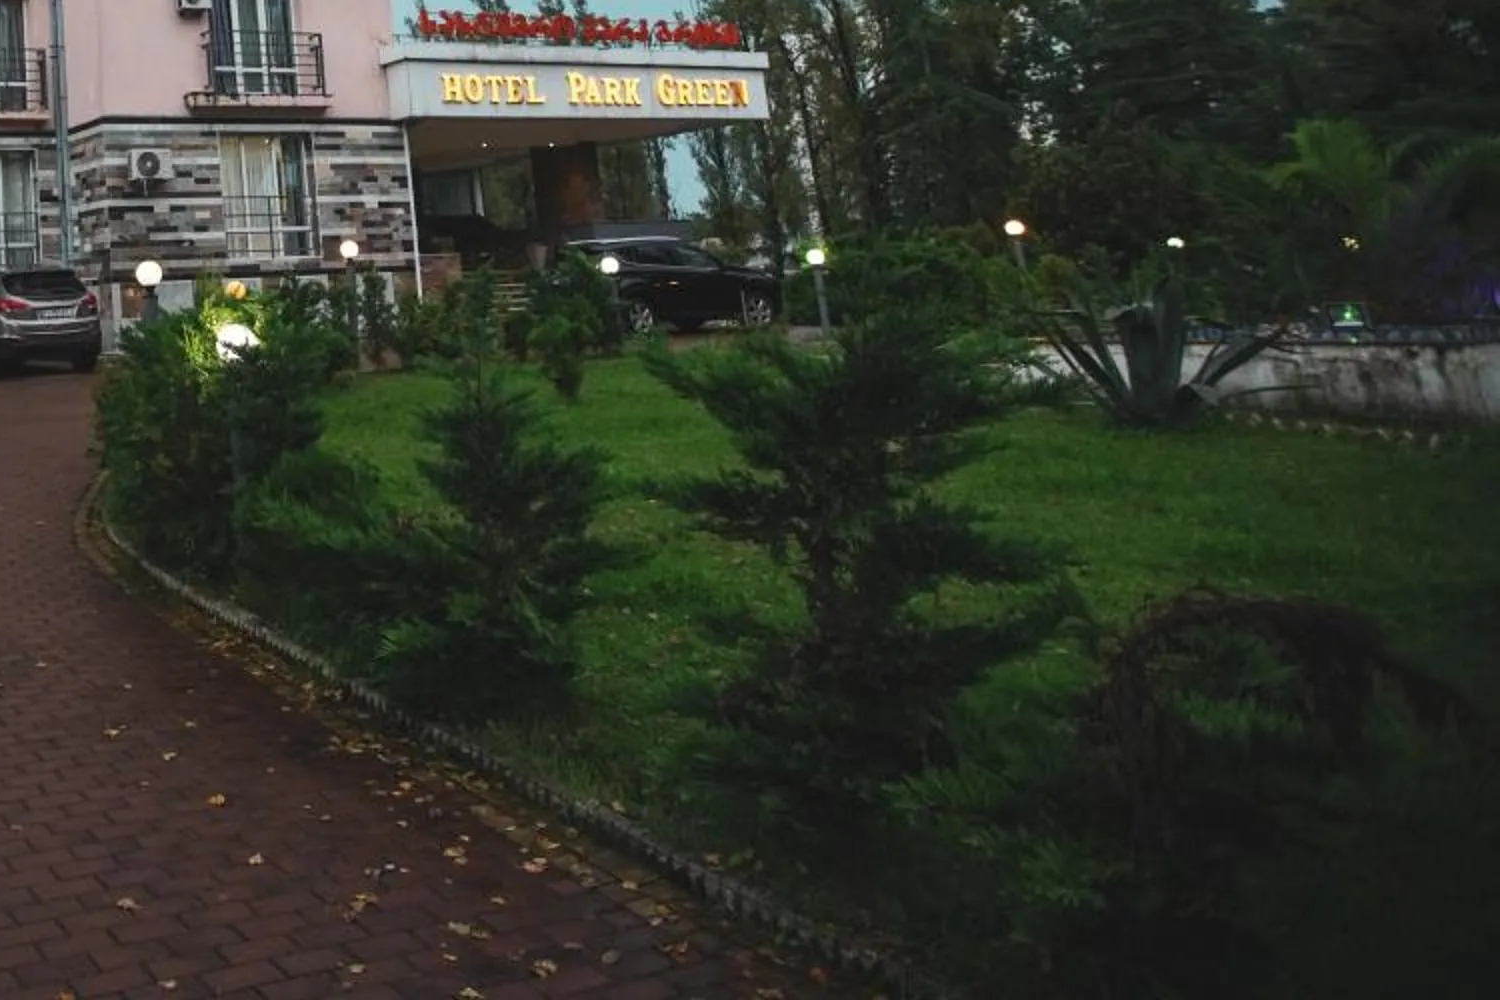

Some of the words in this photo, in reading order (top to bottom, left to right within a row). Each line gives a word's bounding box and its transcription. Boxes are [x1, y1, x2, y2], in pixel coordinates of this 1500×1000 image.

[443, 73, 545, 105] HOTEL
[568, 72, 641, 106] PARK
[656, 74, 749, 107] GREEN
